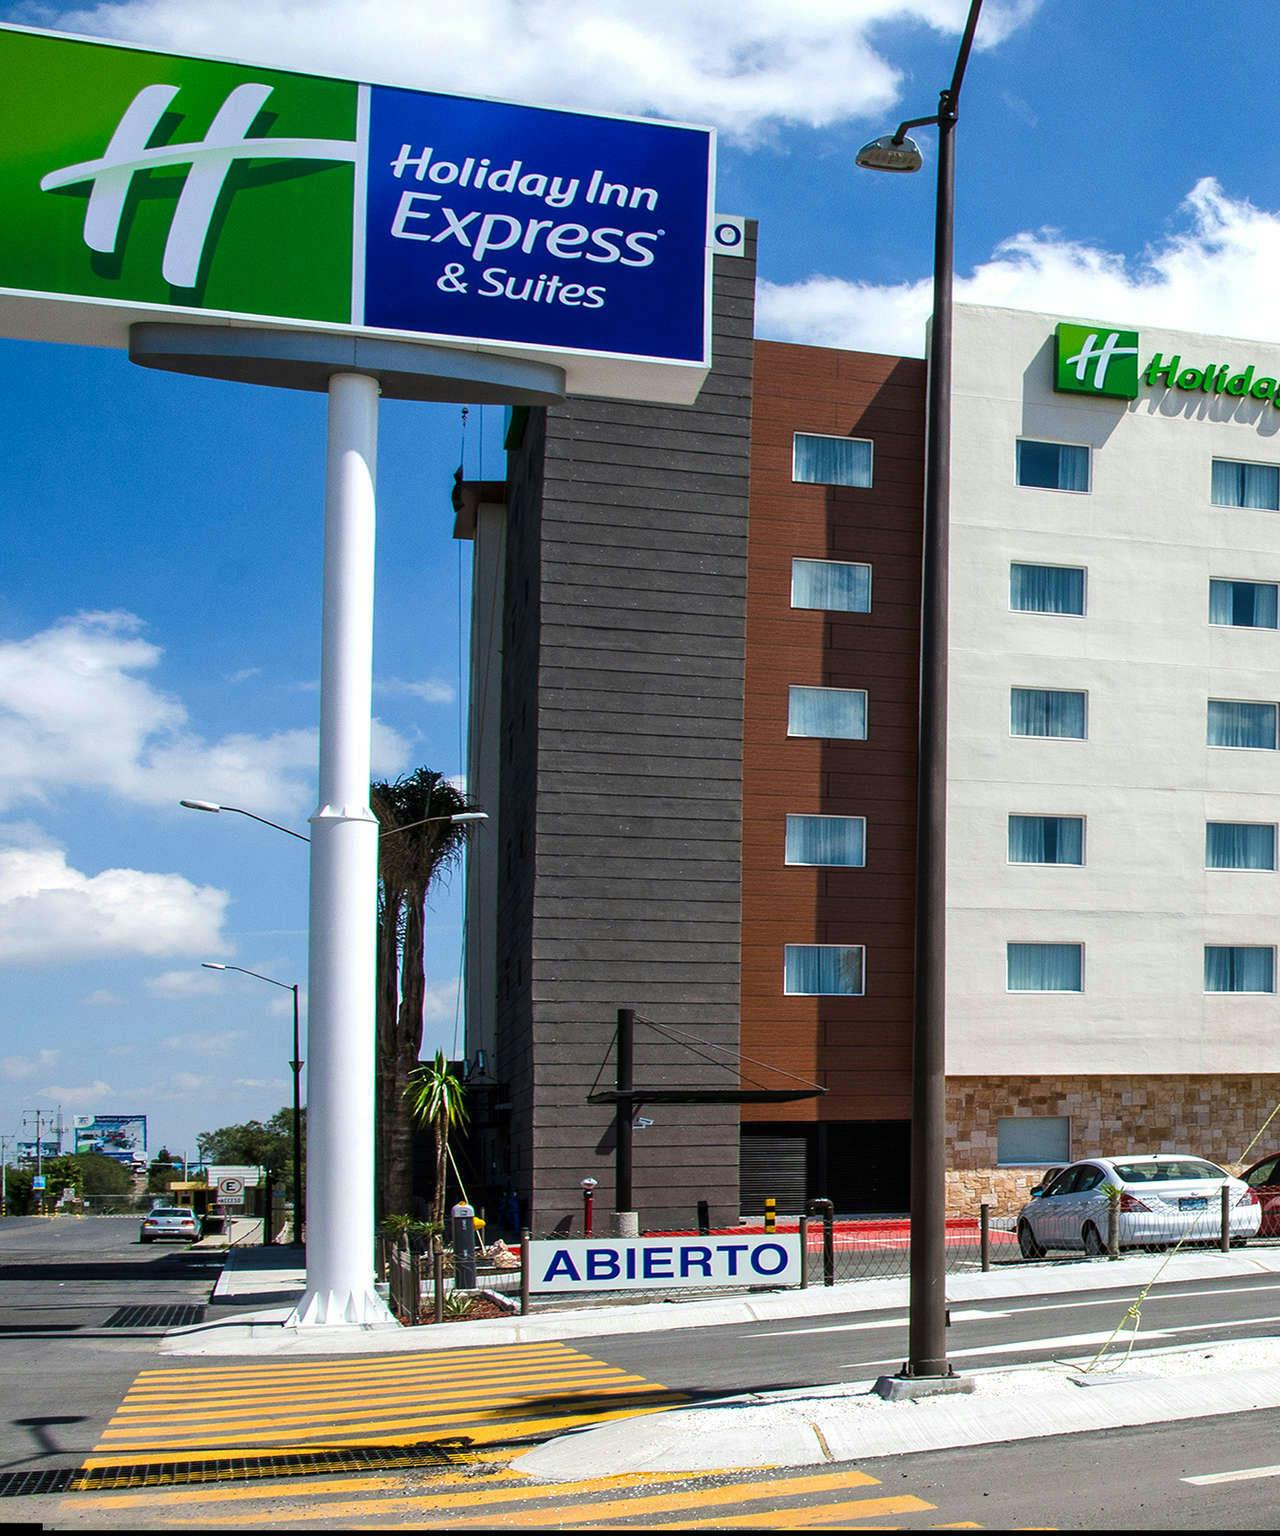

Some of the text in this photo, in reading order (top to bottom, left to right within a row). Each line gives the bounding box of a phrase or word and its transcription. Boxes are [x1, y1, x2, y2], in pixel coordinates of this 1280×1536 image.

[390, 144, 659, 211] Holiday Inn
[390, 190, 655, 267] Express
[436, 263, 606, 309] & Suites
[542, 1242, 789, 1282] ABIERTO
